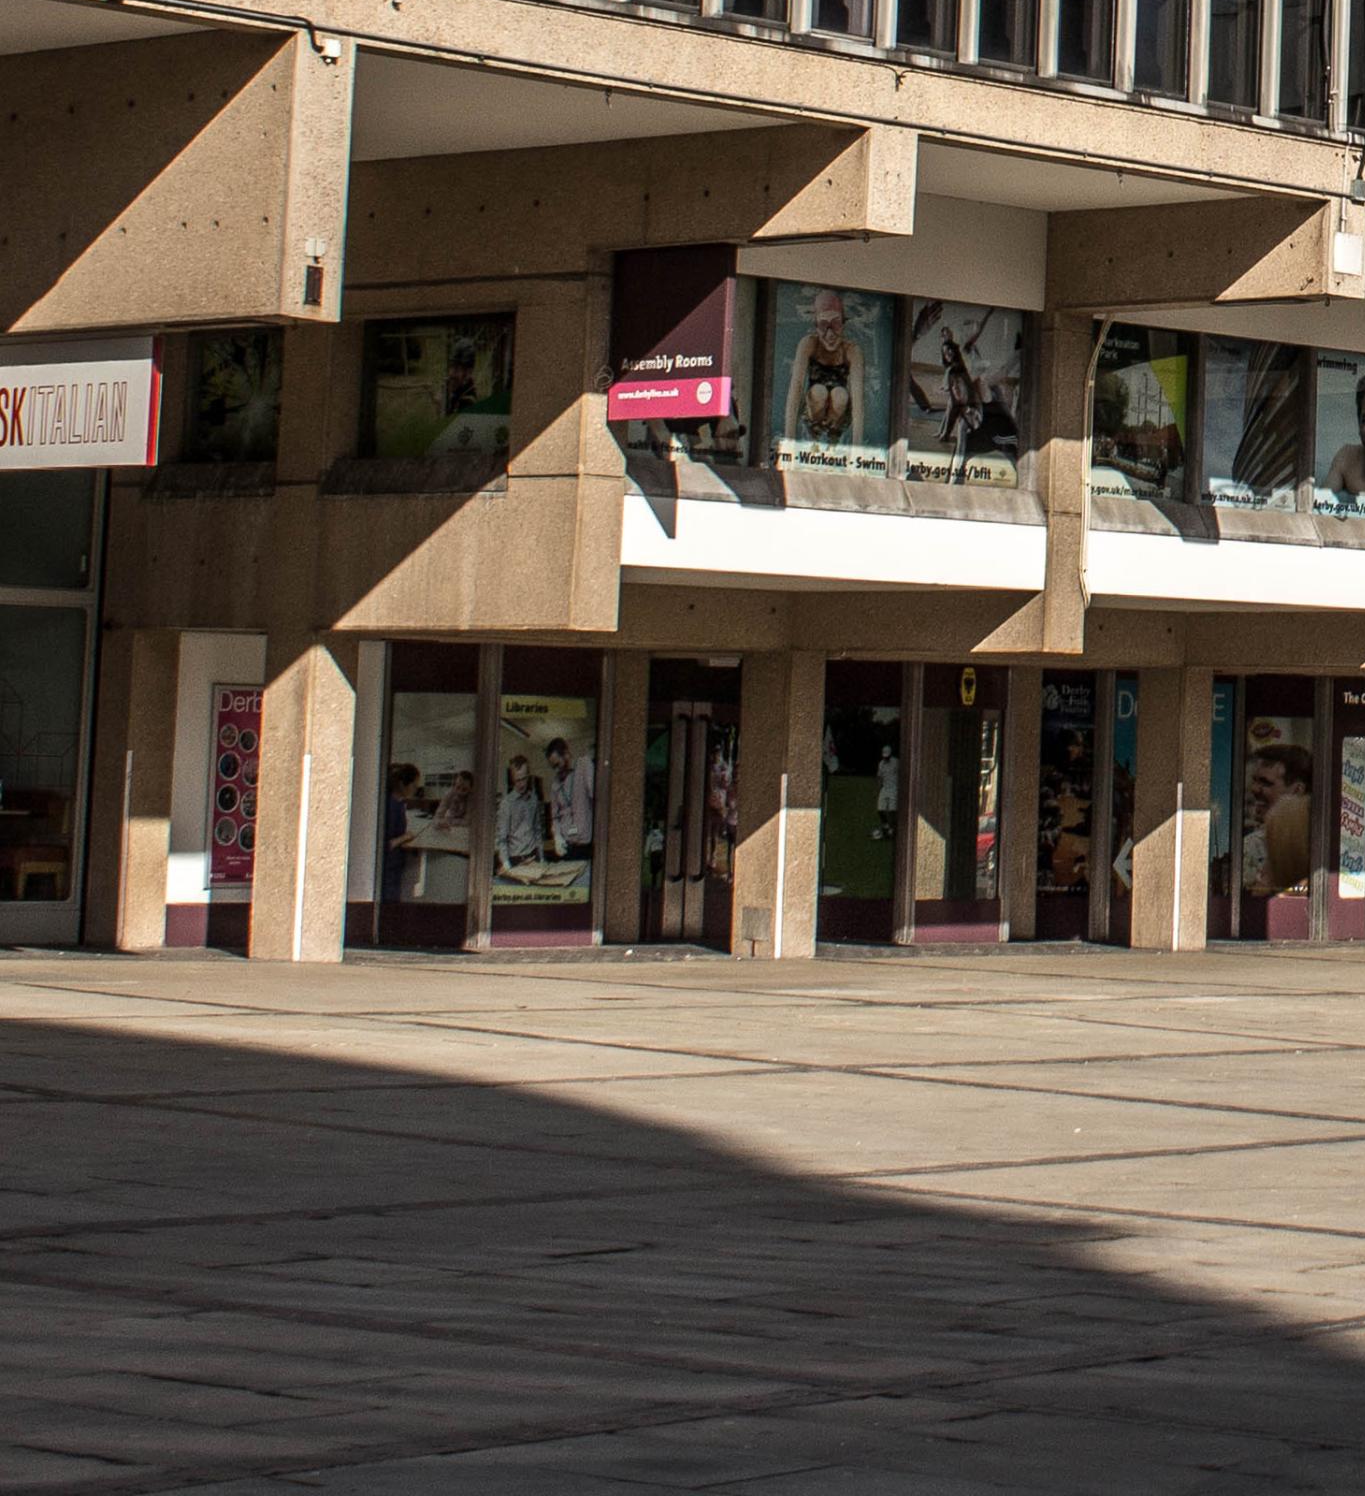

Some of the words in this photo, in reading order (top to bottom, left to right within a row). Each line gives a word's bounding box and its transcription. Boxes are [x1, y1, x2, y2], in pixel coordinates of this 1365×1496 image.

[621, 354, 674, 373] Assembly
[675, 354, 713, 368] Rooms
[799, 451, 848, 467] Workout
[856, 456, 886, 471] Swim
[218, 688, 262, 713] Derb
[505, 701, 548, 713] Libraries
[1344, 691, 1359, 705] The
